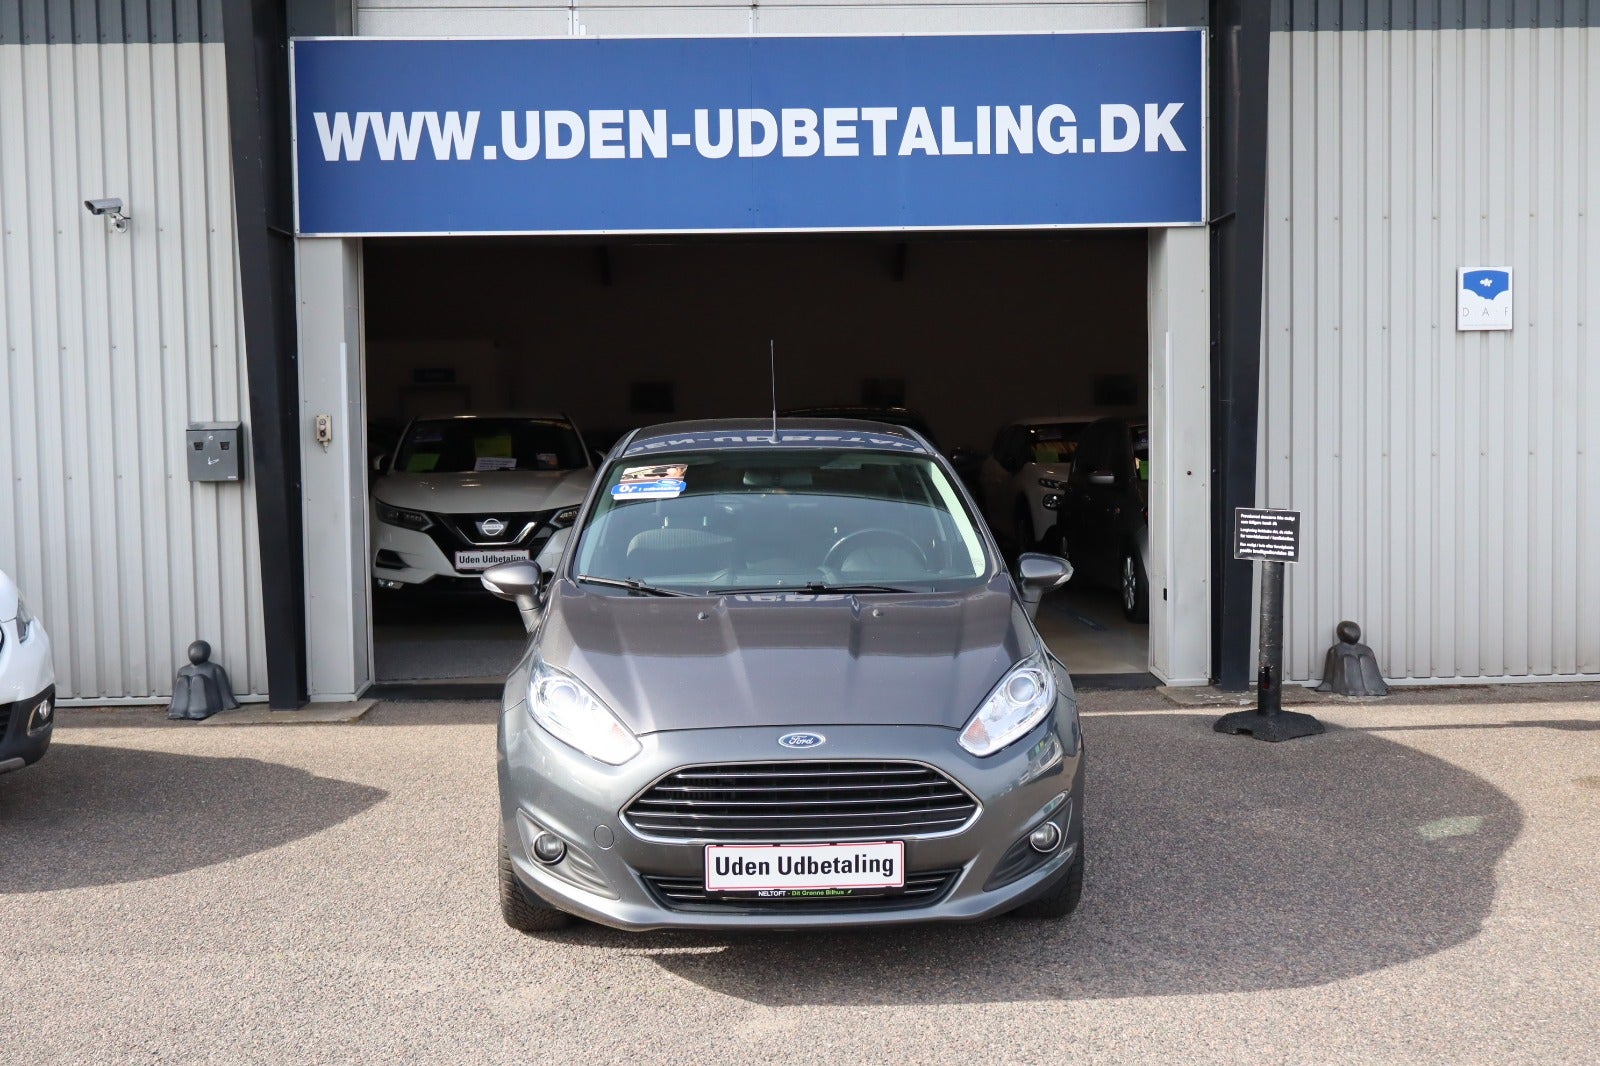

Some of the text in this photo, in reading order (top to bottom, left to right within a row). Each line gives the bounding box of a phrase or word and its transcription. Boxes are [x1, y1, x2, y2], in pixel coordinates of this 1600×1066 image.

[313, 102, 1187, 162] WWW.UDEN-UDBETALING.DK
[459, 555, 480, 564] Uden
[788, 735, 814, 745] Ford
[715, 853, 895, 877] Uden Udbetaling
